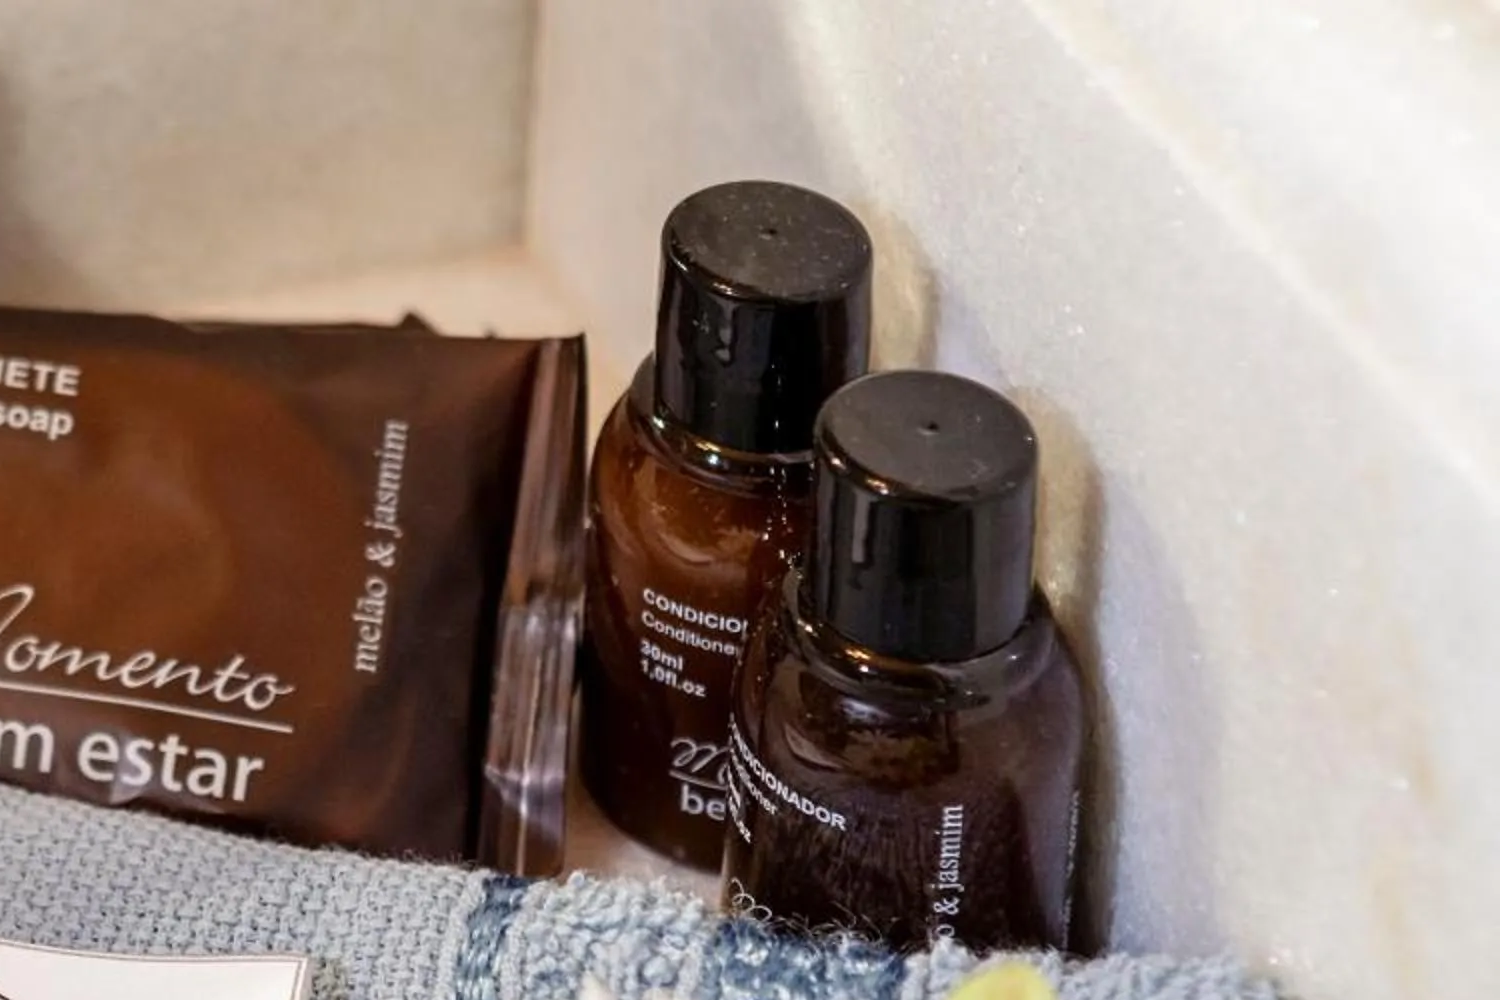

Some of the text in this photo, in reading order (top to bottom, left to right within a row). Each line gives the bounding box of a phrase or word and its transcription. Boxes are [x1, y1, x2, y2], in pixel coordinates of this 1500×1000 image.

[364, 419, 409, 539] jasmim
[365, 541, 397, 568] &
[643, 588, 748, 636] CONDICIO
[77, 725, 265, 802] estar
[681, 783, 726, 821] be
[931, 804, 965, 893] jasmim
[933, 897, 960, 916] &
